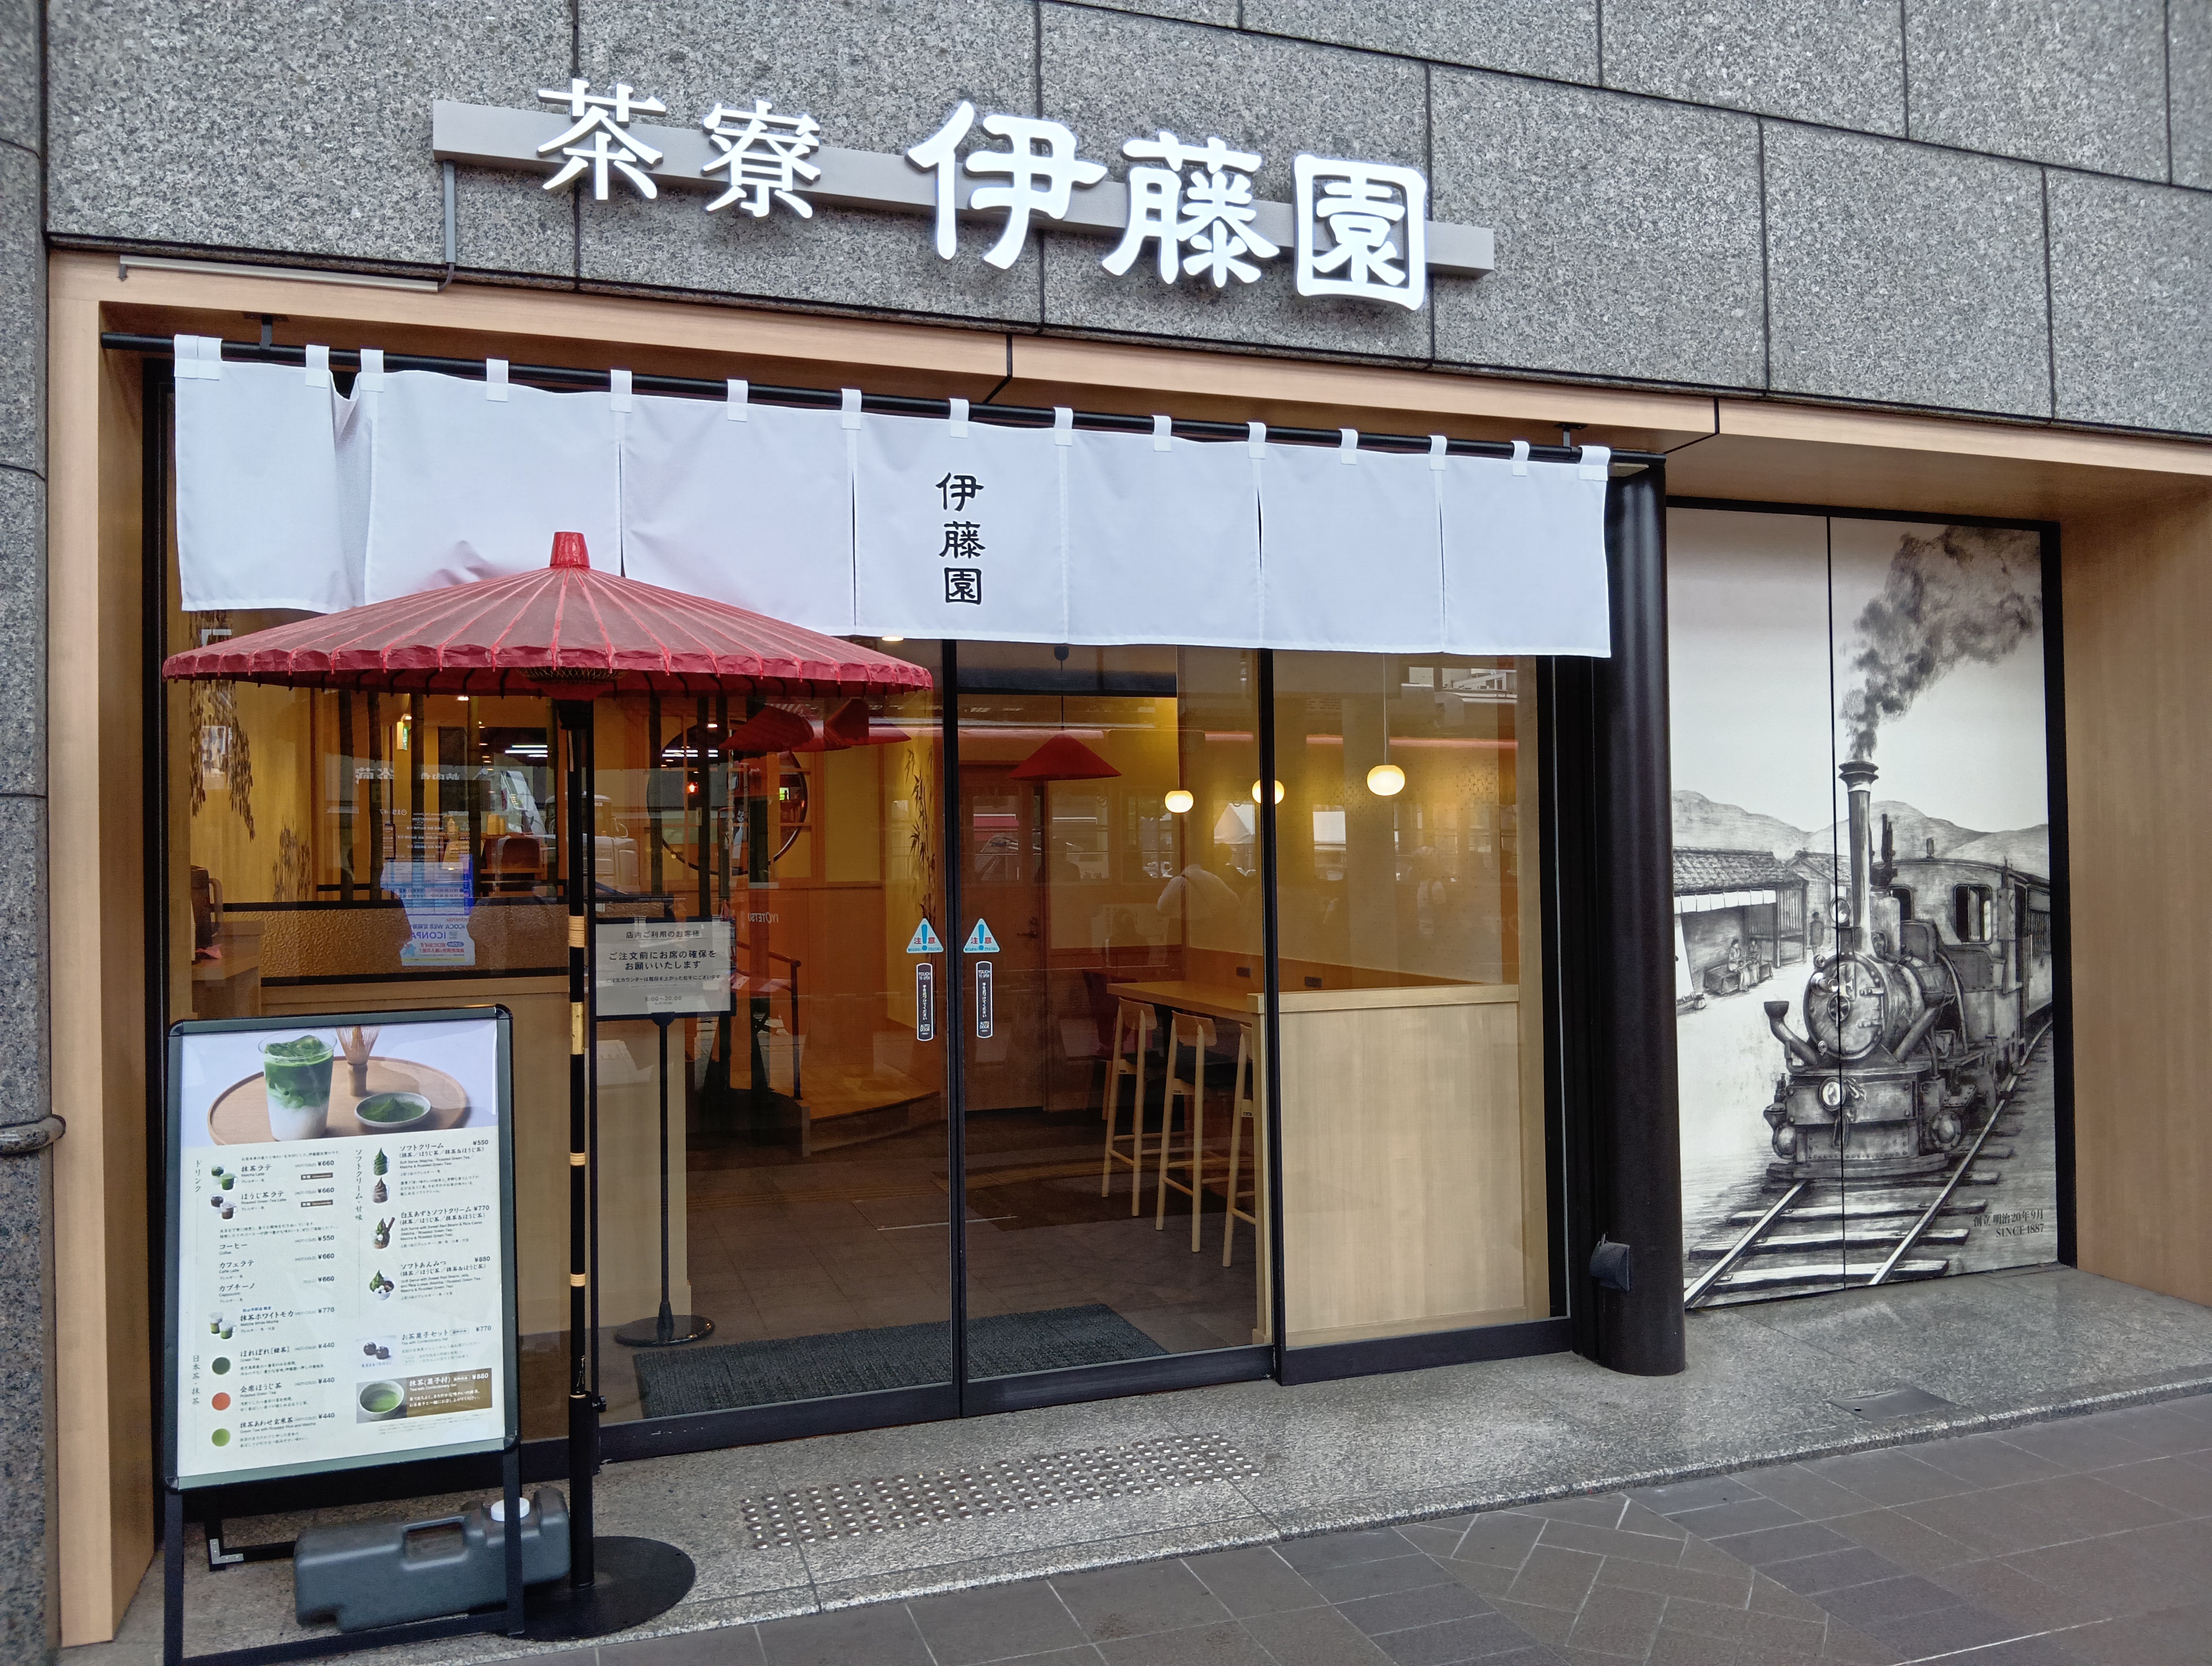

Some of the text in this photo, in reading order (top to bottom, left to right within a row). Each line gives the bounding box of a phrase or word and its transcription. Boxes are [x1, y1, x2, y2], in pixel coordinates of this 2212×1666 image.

[537, 78, 1428, 310] 茶寮 伊藤園
[935, 472, 986, 605] 伊藤園
[626, 930, 700, 939] 店内ご利用のお客様
[609, 949, 716, 960] ご注文前にお席の確保を
[625, 960, 700, 970] お願いいたします
[400, 1143, 444, 1151] ソフトクリーム
[241, 1164, 272, 1172] 抹茶ラテ
[355, 1150, 363, 1221] ソフトクリーム・甘味
[241, 1190, 284, 1200] ほうじ茶ラテ
[401, 1208, 471, 1219] 白玉あずきソフトクリーム
[1993, 1209, 2043, 1225] 明治20年9月
[1996, 1223, 2044, 1238] SINCE 1887
[219, 1259, 255, 1268] カフェラテ
[401, 1260, 447, 1270] ソフトあんみつ
[219, 1283, 255, 1292] カプチーノ
[240, 1311, 294, 1322] 抹茶ホワイトモカ
[402, 1329, 448, 1340] お茶菓子セット
[191, 1355, 201, 1405] 日本茶・抹茶
[409, 1376, 451, 1387] 抹茶(菓子付)
[240, 1382, 282, 1393] 会席ほうじ茶
[240, 1417, 293, 1428] 抹茶あわせ玄米茶
